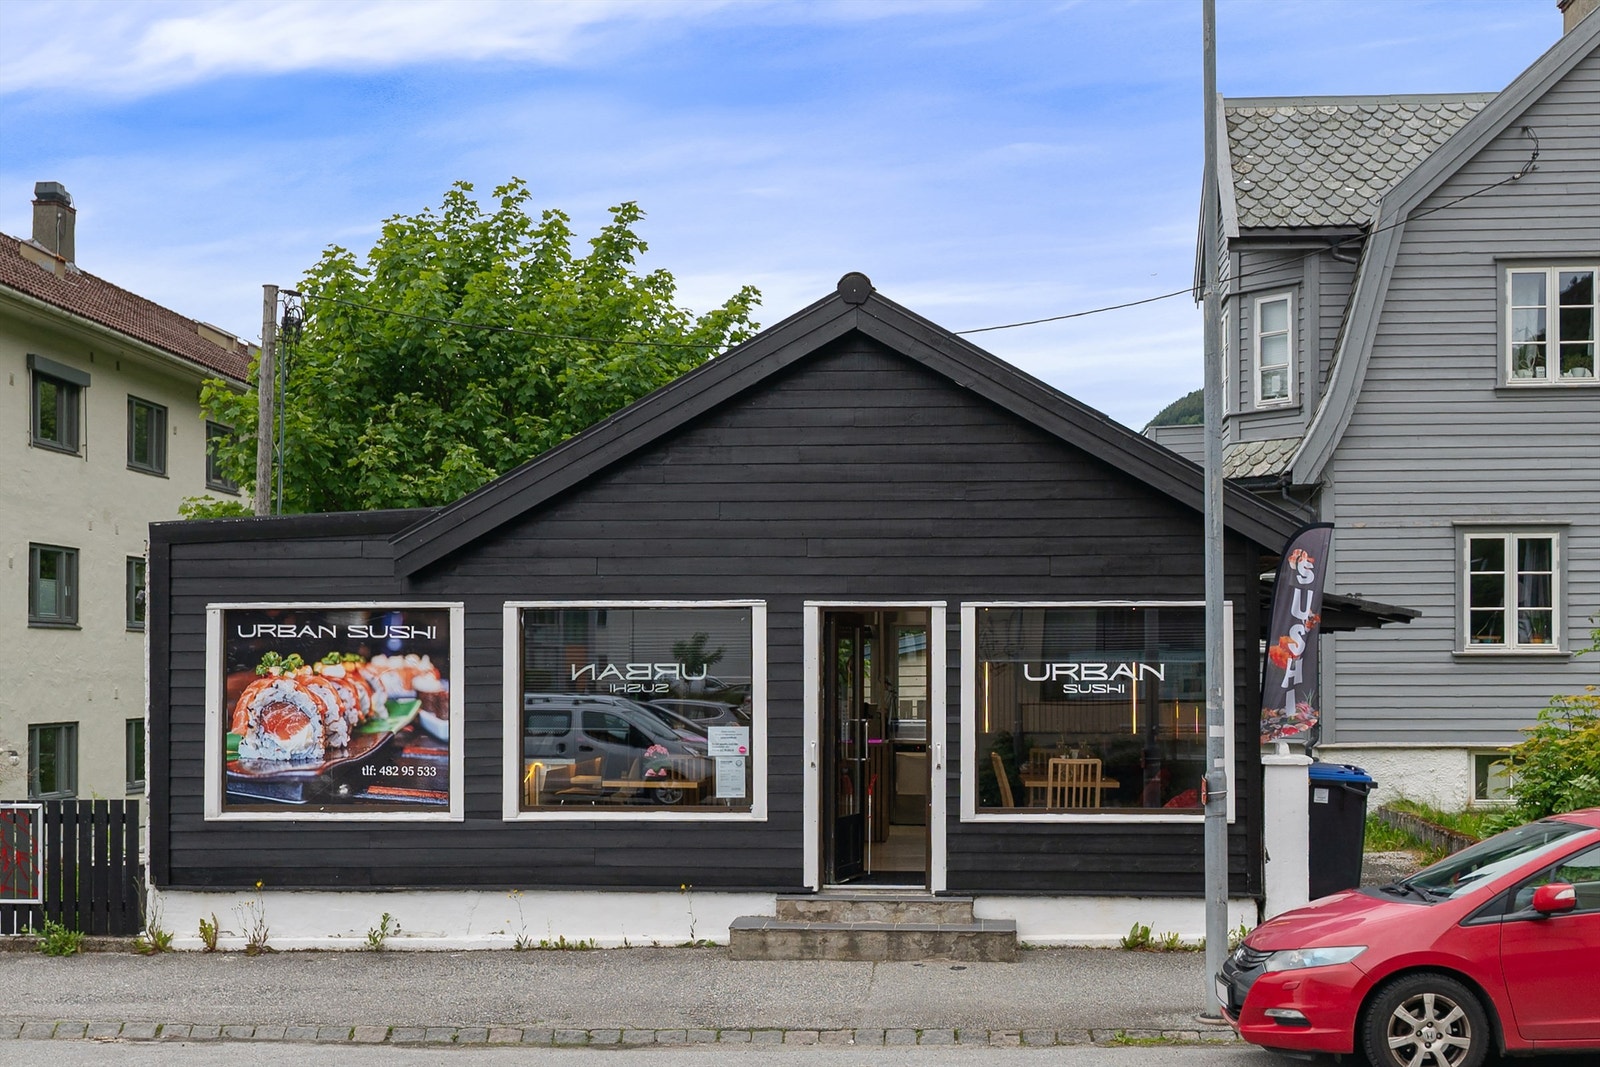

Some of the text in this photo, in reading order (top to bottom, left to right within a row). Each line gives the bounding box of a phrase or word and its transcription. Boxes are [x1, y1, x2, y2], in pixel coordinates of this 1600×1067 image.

[237, 624, 437, 639] URBAN SUSHI
[1280, 557, 1315, 717] SUSHI
[1023, 663, 1165, 682] URBAN
[1063, 684, 1125, 694] SUSHI
[361, 765, 437, 777] tlf: 482 95 533
